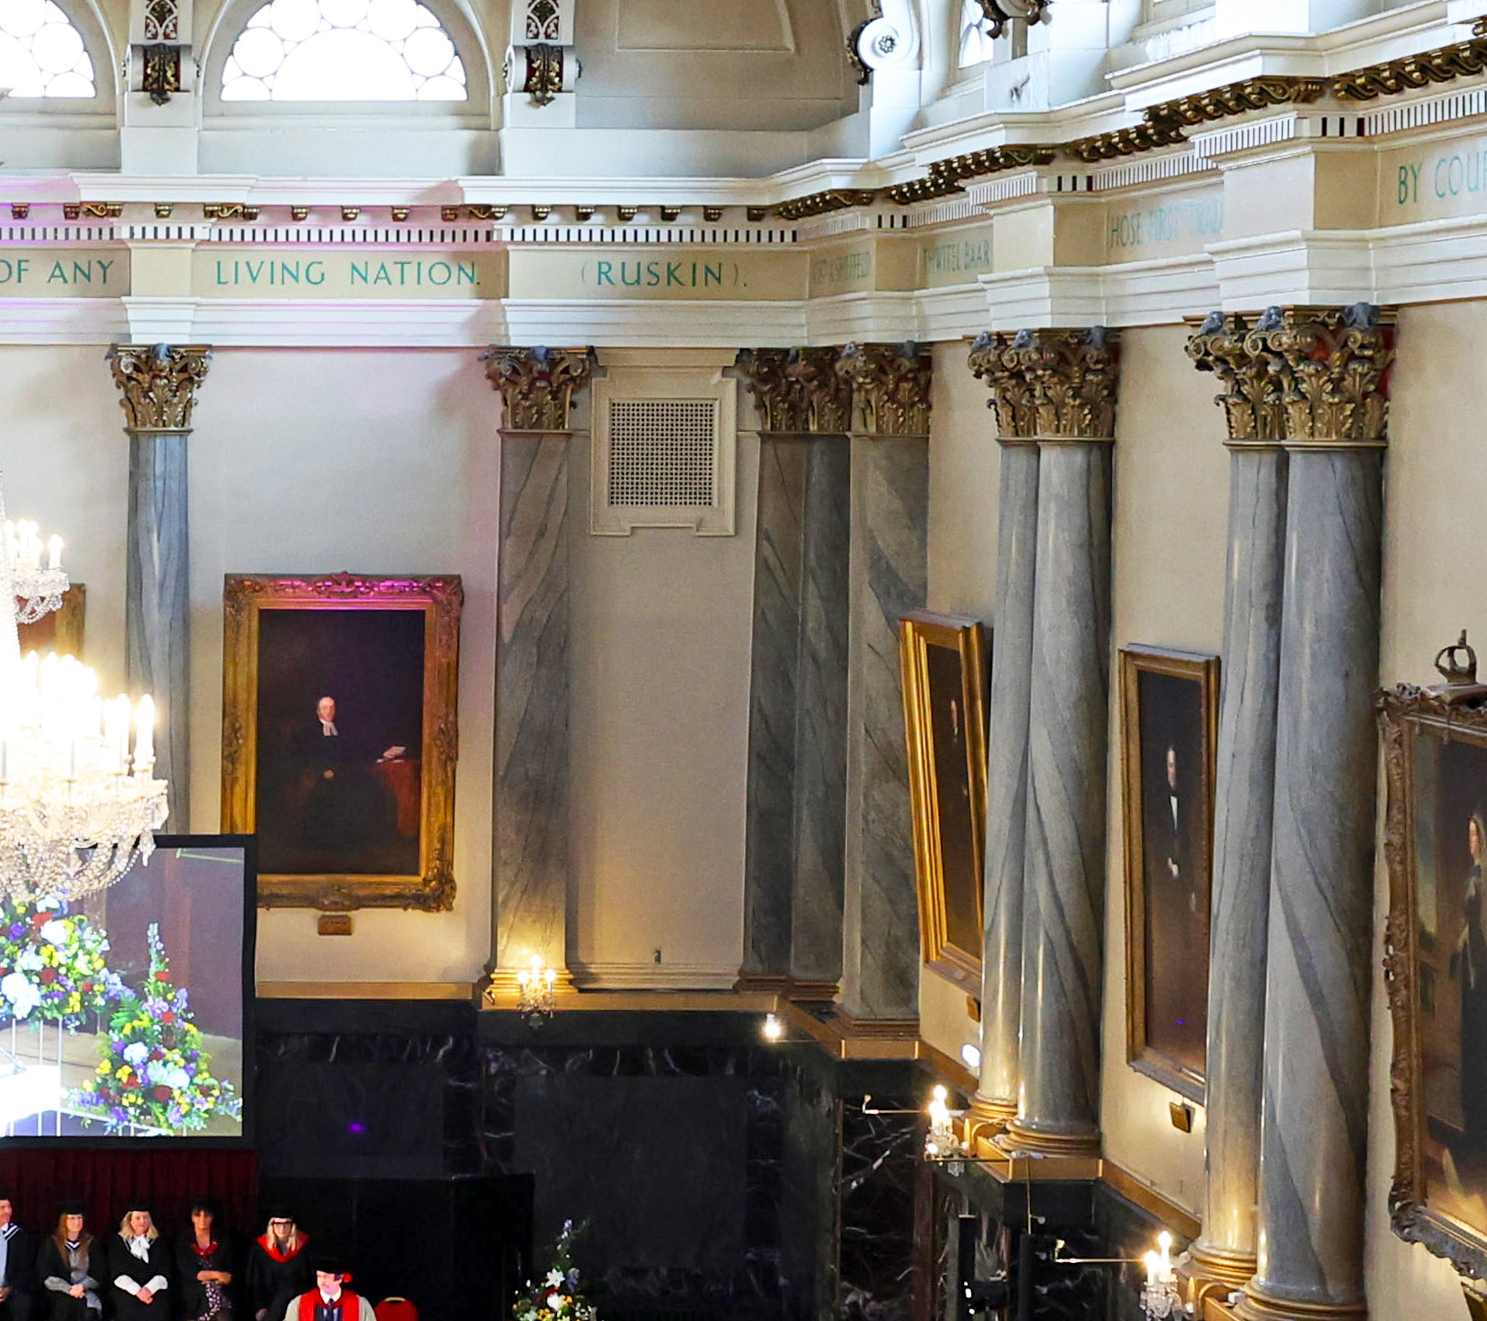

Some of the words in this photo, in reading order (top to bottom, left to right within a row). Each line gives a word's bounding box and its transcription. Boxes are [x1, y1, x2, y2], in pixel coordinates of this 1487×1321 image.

[1397, 161, 1423, 205] BY
[47, 259, 115, 285] ANY
[216, 260, 326, 286] LIVING
[350, 260, 481, 287] NATION.
